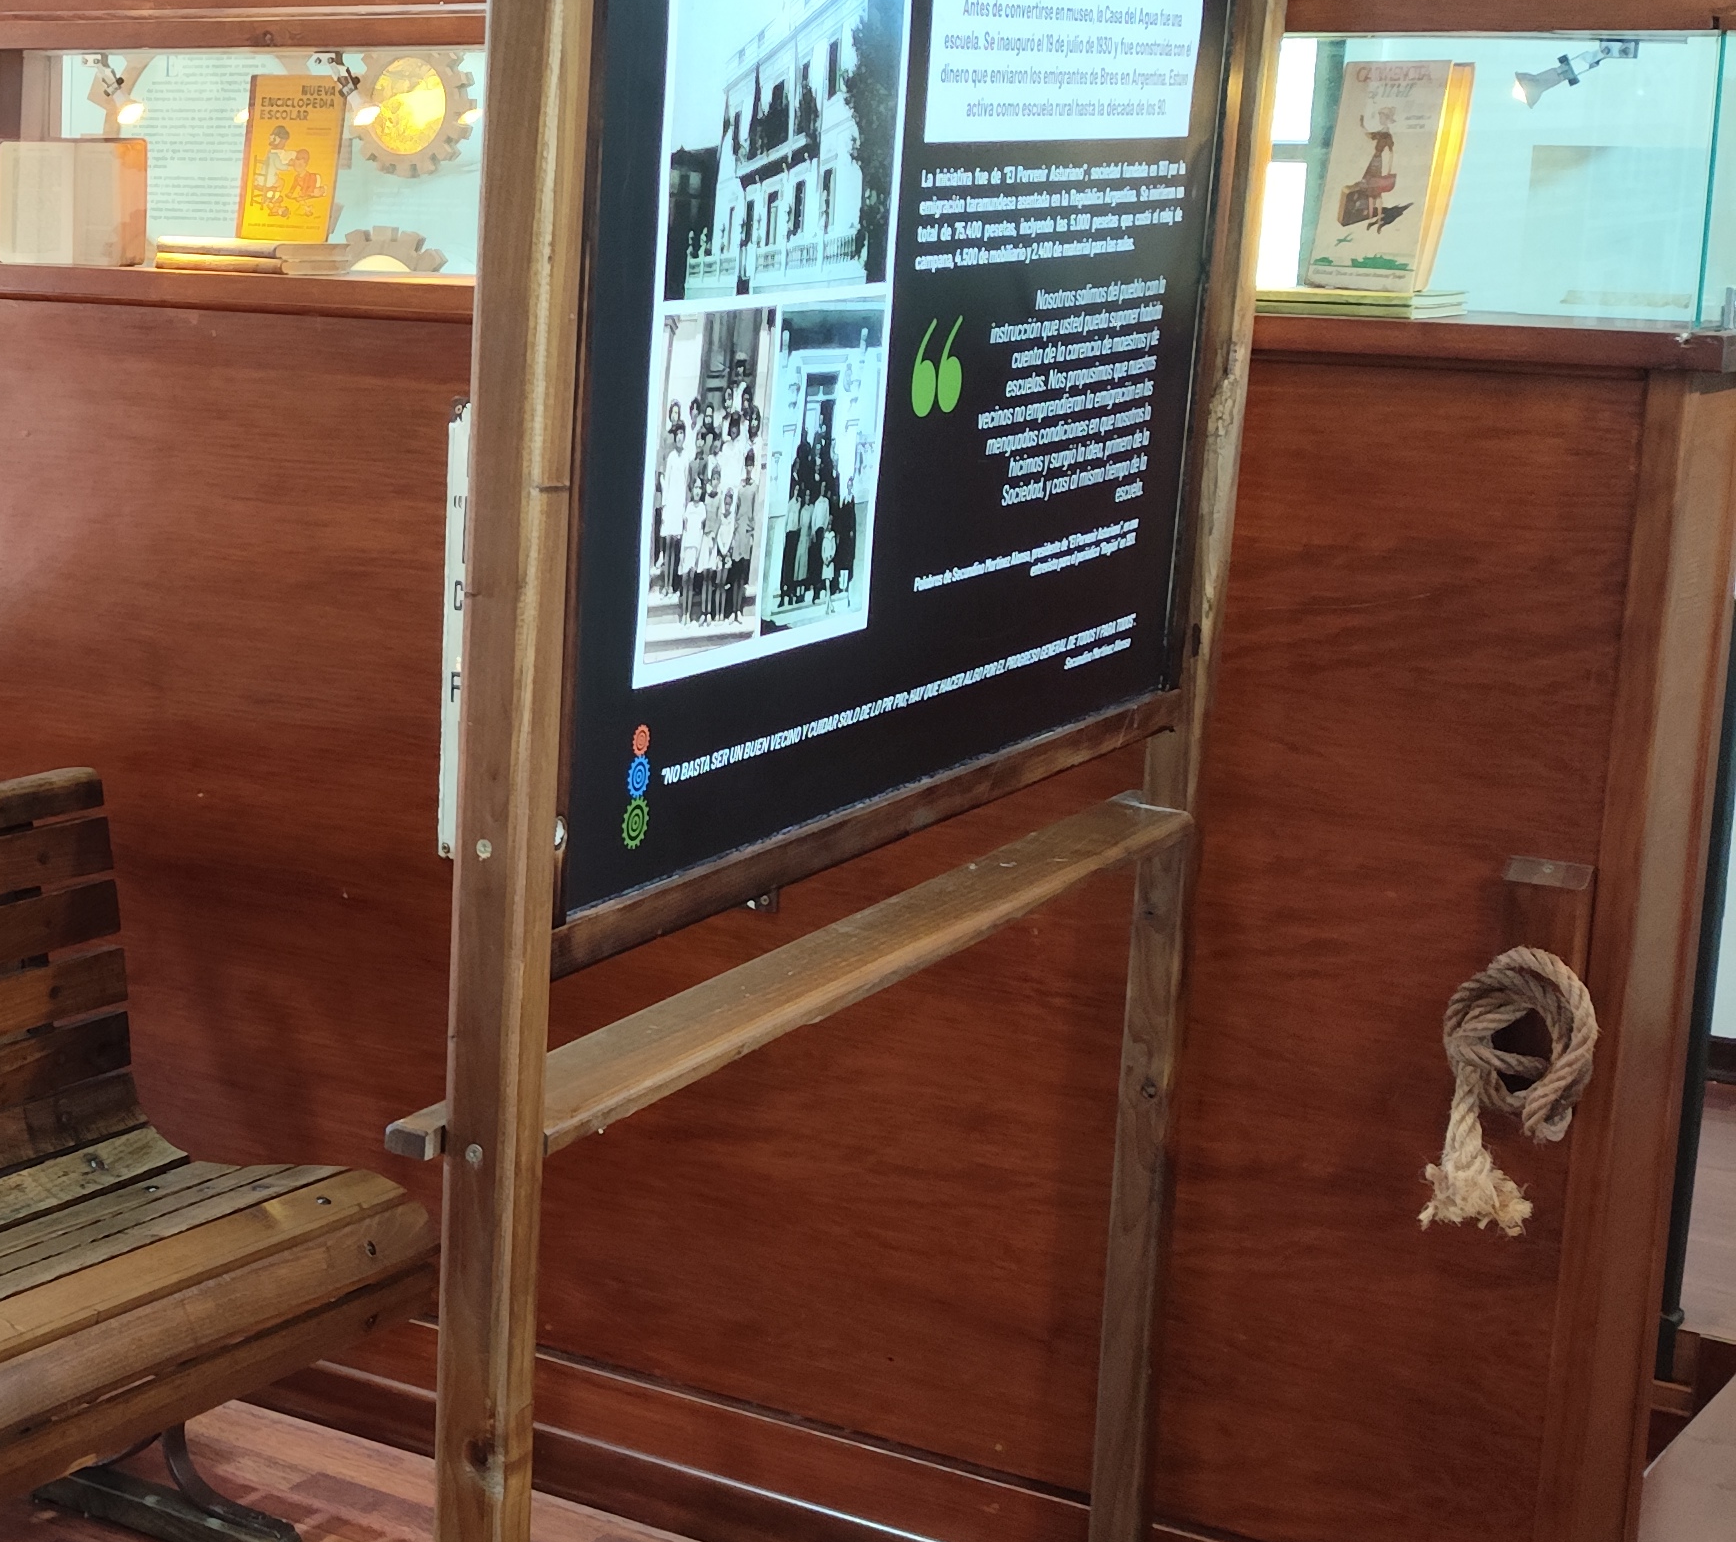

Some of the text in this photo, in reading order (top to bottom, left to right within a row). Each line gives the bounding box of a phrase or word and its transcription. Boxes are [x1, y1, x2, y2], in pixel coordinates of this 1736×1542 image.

[1005, 1, 1053, 20] convertirse
[1056, 7, 1064, 20] en
[1067, 8, 1094, 24] museo,
[1097, 5, 1103, 23] la
[1105, 5, 1122, 24] Casa
[1125, 7, 1136, 24] del
[1138, 8, 1158, 30] Agua
[1160, 9, 1170, 26] fue
[1172, 14, 1182, 27] una
[945, 30, 1192, 59] escuela. Se inauguró el 19 de julio de 1930 y fue construida con el
[941, 63, 969, 83] dinero
[972, 70, 988, 88] que
[990, 65, 1028, 84] enviaron
[1030, 66, 1041, 84] los
[1043, 66, 1088, 89] emigrantes
[1090, 68, 1098, 85] de
[1101, 67, 1118, 85] Bres
[1121, 72, 1130, 85] en
[1132, 68, 1167, 90] Argentina.
[301, 84, 336, 97] NUEVA
[260, 96, 335, 109] ENCICLOPEDIA
[966, 98, 993, 117] activa
[996, 103, 1020, 117] como
[1022, 98, 1054, 117] escuela
[1056, 99, 1074, 116] rural
[1075, 99, 1095, 116] hasta
[1098, 99, 1104, 116] la
[1107, 99, 1135, 116] década
[1136, 99, 1145, 116] de
[1146, 99, 1156, 116] los
[260, 110, 309, 121] ESCOLAR
[921, 170, 933, 187] La
[936, 168, 972, 186] iniciativa
[975, 168, 988, 184] fue
[991, 167, 1001, 184] de
[917, 224, 938, 242] total
[940, 223, 952, 241] de
[955, 221, 982, 239] 75.400
[915, 254, 954, 272] campana,
[955, 247, 978, 266] 4.500
[978, 247, 988, 264] de
[1036, 289, 1075, 310] Nosotros
[990, 318, 1041, 343] instrucción
[1042, 320, 1059, 341] que
[1060, 312, 1084, 335] usted
[1043, 340, 1056, 363] de
[1048, 369, 1066, 389] Nos
[978, 406, 1013, 429] vecinos
[1013, 406, 1025, 422] no
[1009, 452, 1043, 477] hicimos
[1043, 455, 1050, 473] y
[681, 755, 710, 780] BASTA
[711, 749, 729, 769] SER
[729, 744, 745, 763] UN
[744, 736, 770, 759] BUEN
[770, 726, 802, 750] VECINO
[802, 724, 809, 740] Y
[808, 714, 839, 738] CUIDAR
[838, 707, 860, 728] SOLO
